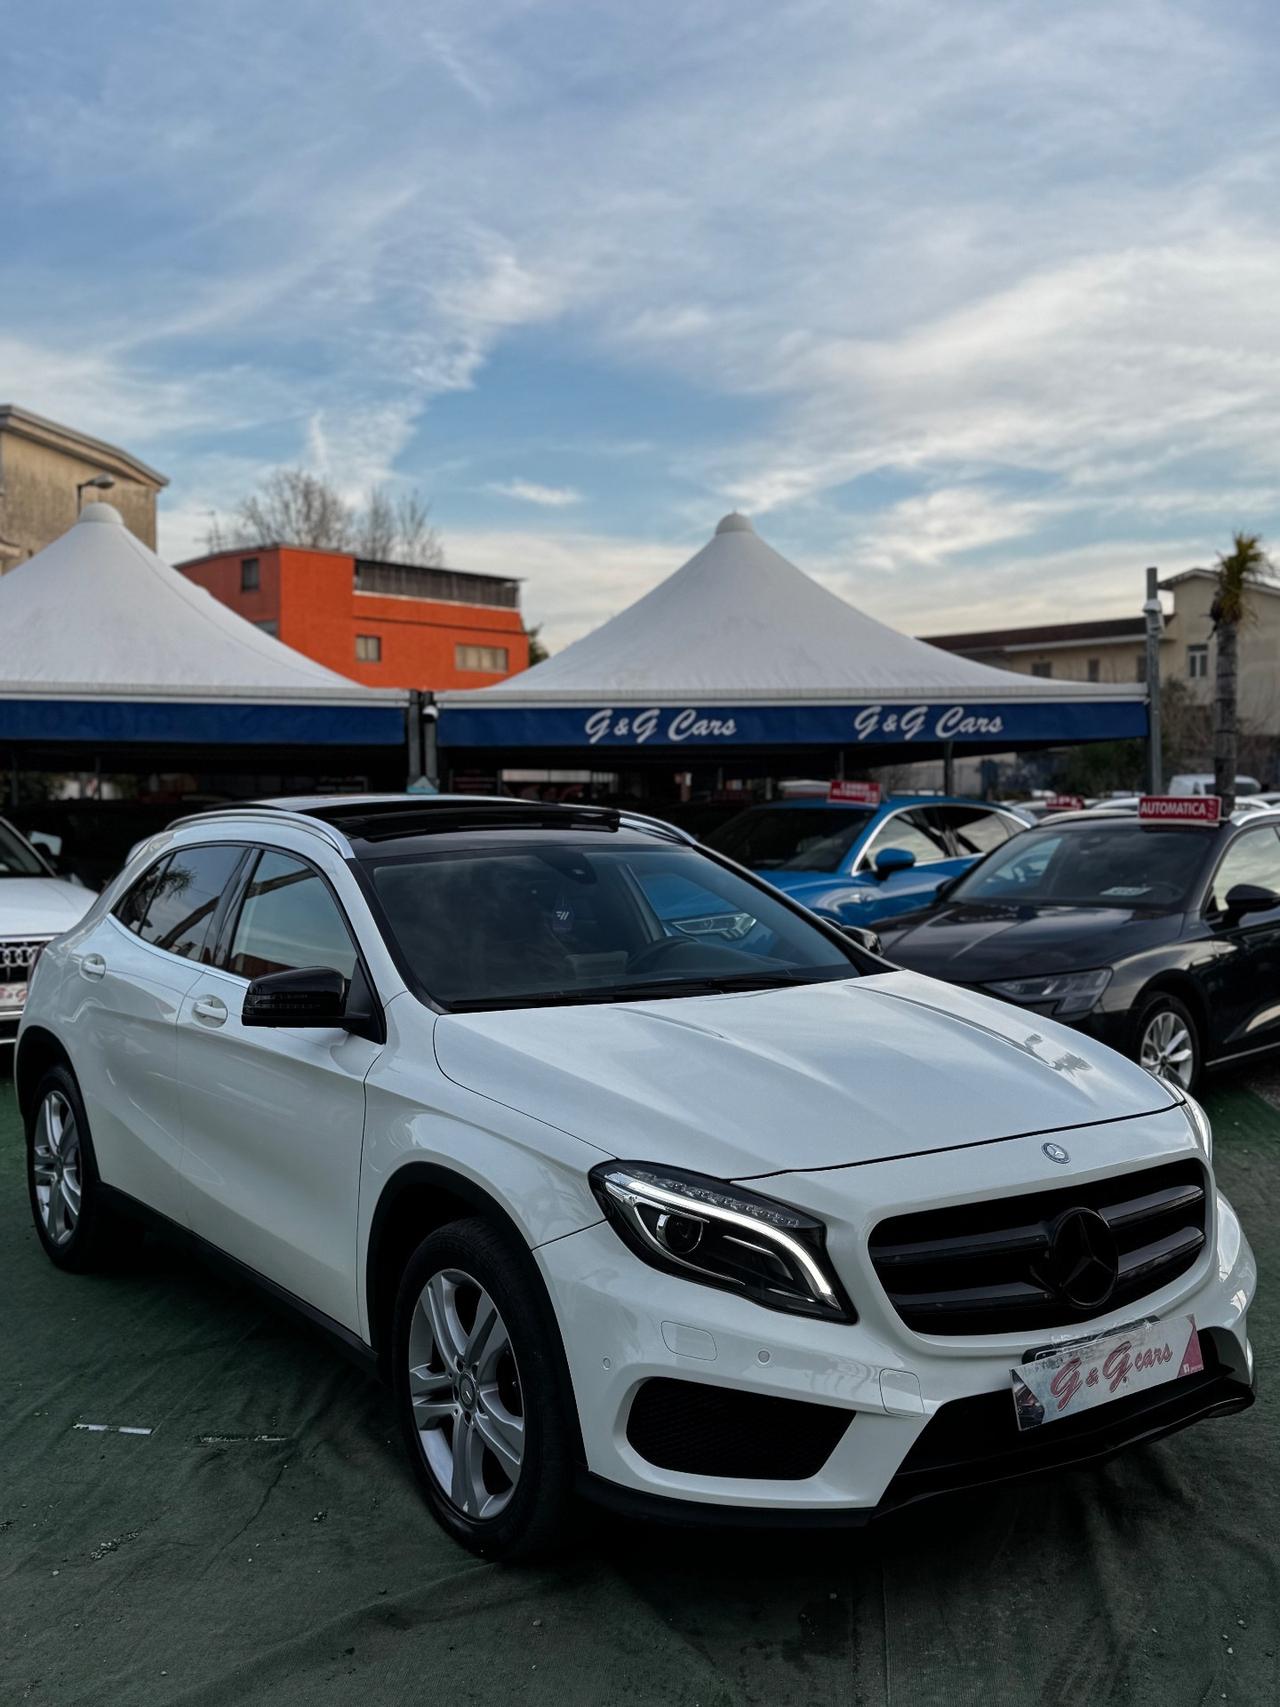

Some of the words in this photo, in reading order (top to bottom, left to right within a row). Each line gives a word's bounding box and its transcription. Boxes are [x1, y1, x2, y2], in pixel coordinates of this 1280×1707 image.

[667, 709, 737, 741] Cars
[935, 706, 1004, 739] Cars
[1140, 801, 1207, 816] AUTOMATICA
